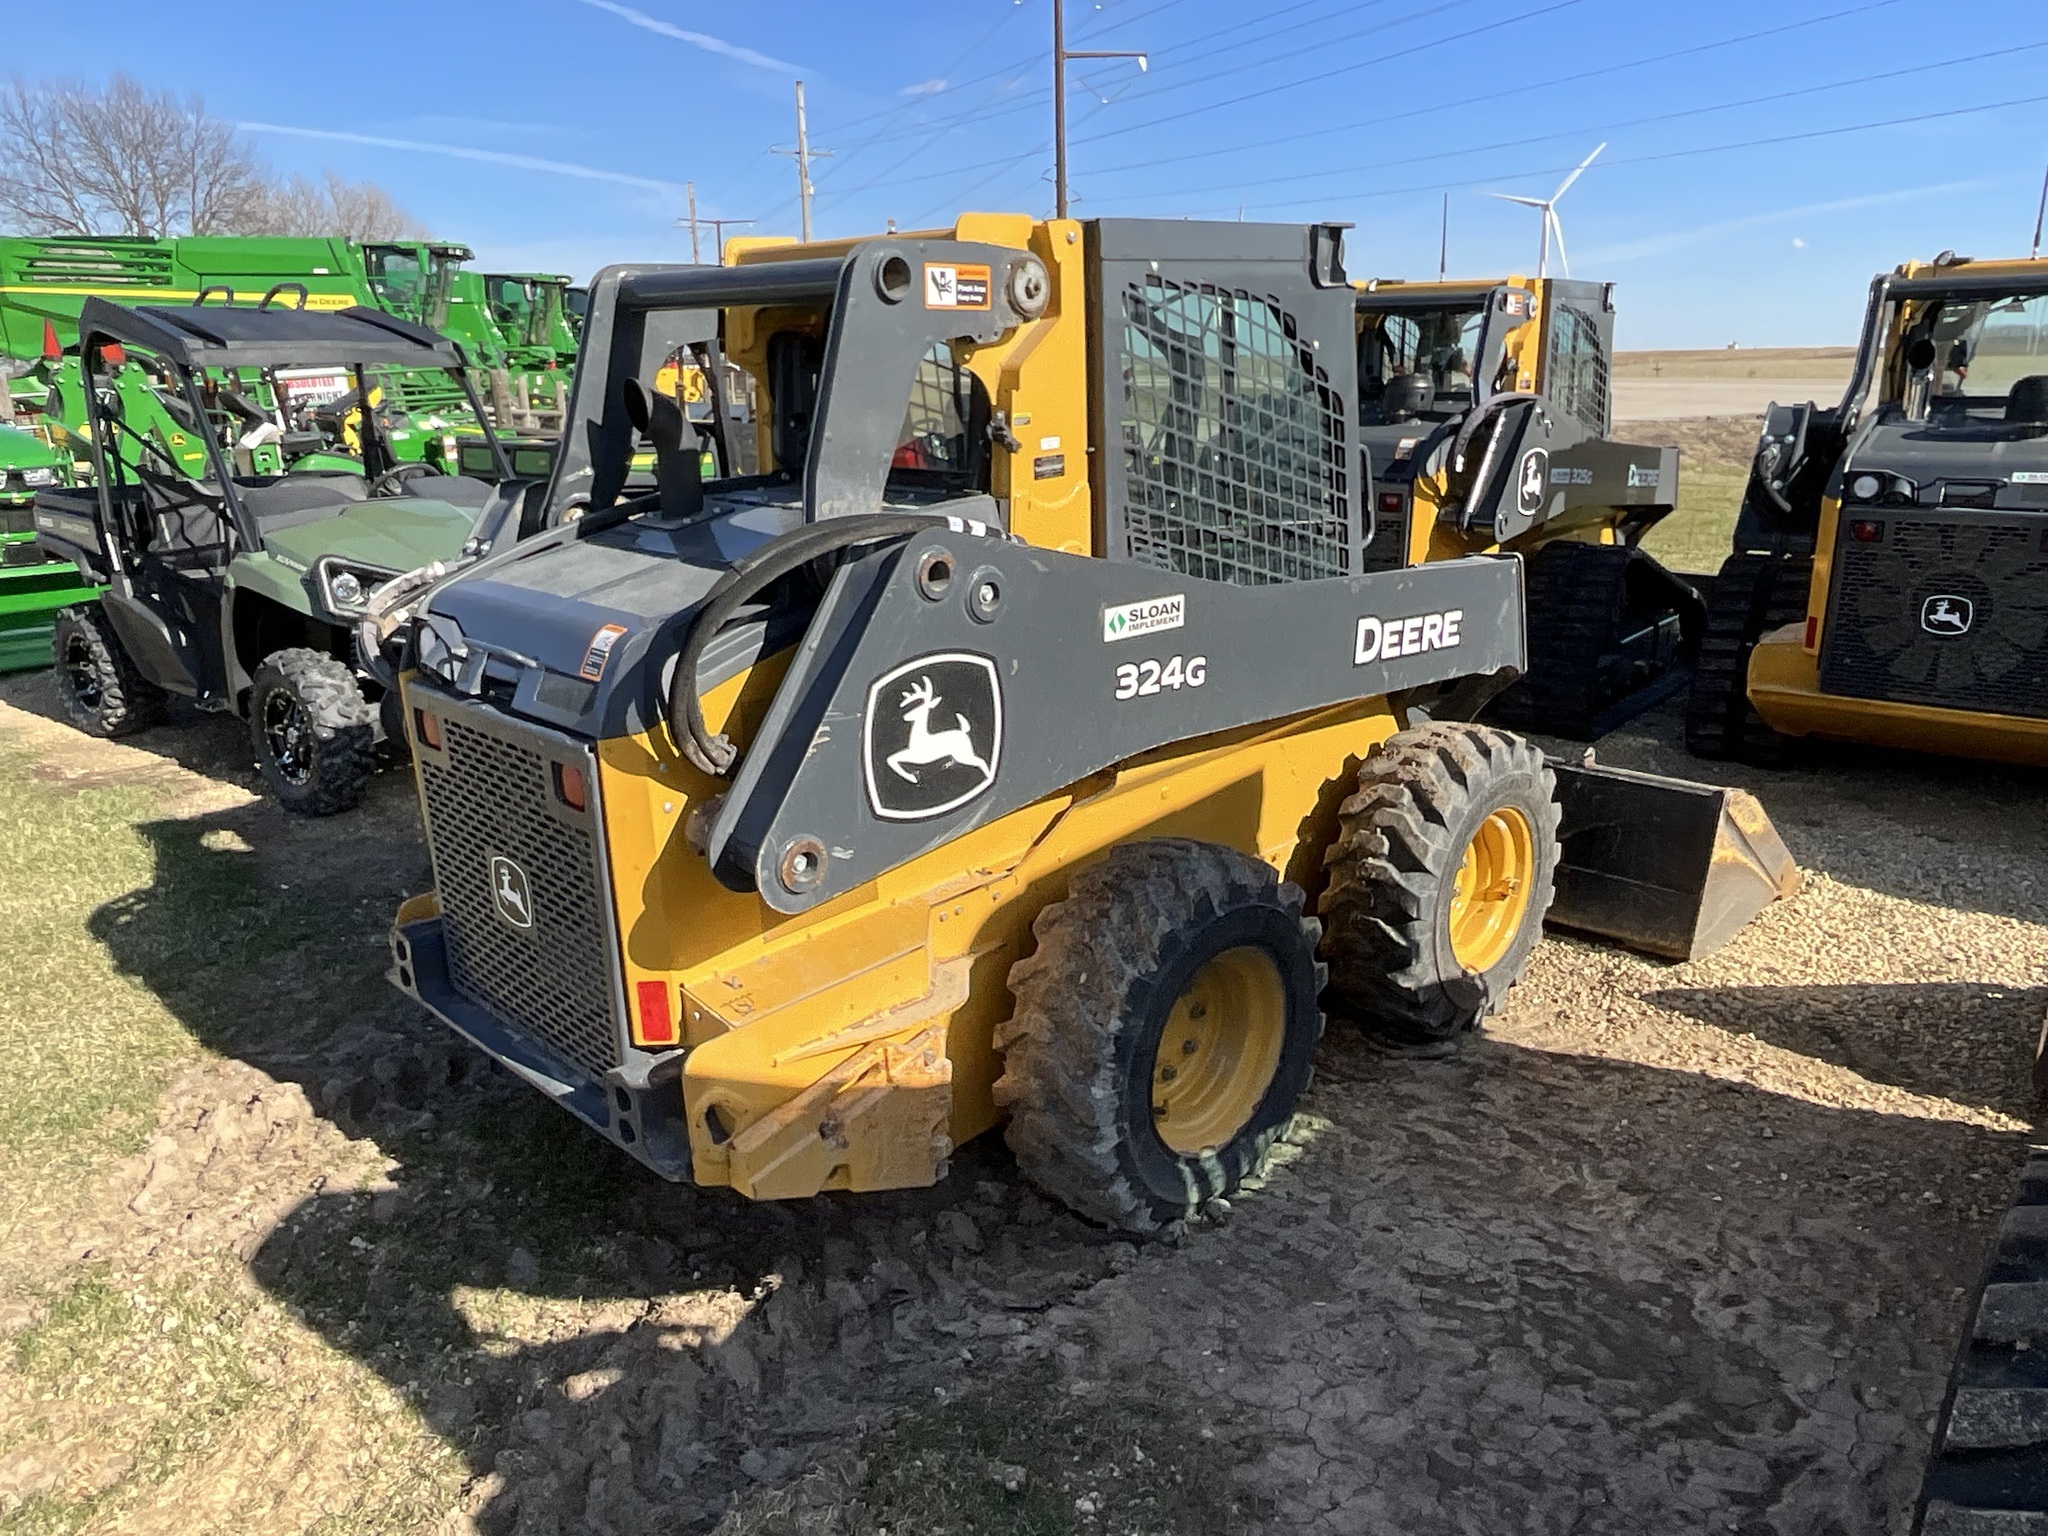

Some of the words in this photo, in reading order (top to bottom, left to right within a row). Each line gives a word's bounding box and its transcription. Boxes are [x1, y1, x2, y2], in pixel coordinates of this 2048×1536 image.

[319, 297, 350, 306] DEERE
[1627, 463, 1660, 487] DEERE
[1128, 600, 1181, 623] SLOAN
[1128, 614, 1181, 632] IMPLEMENT
[1353, 609, 1463, 666] DEERE
[1115, 655, 1207, 700] 324G
